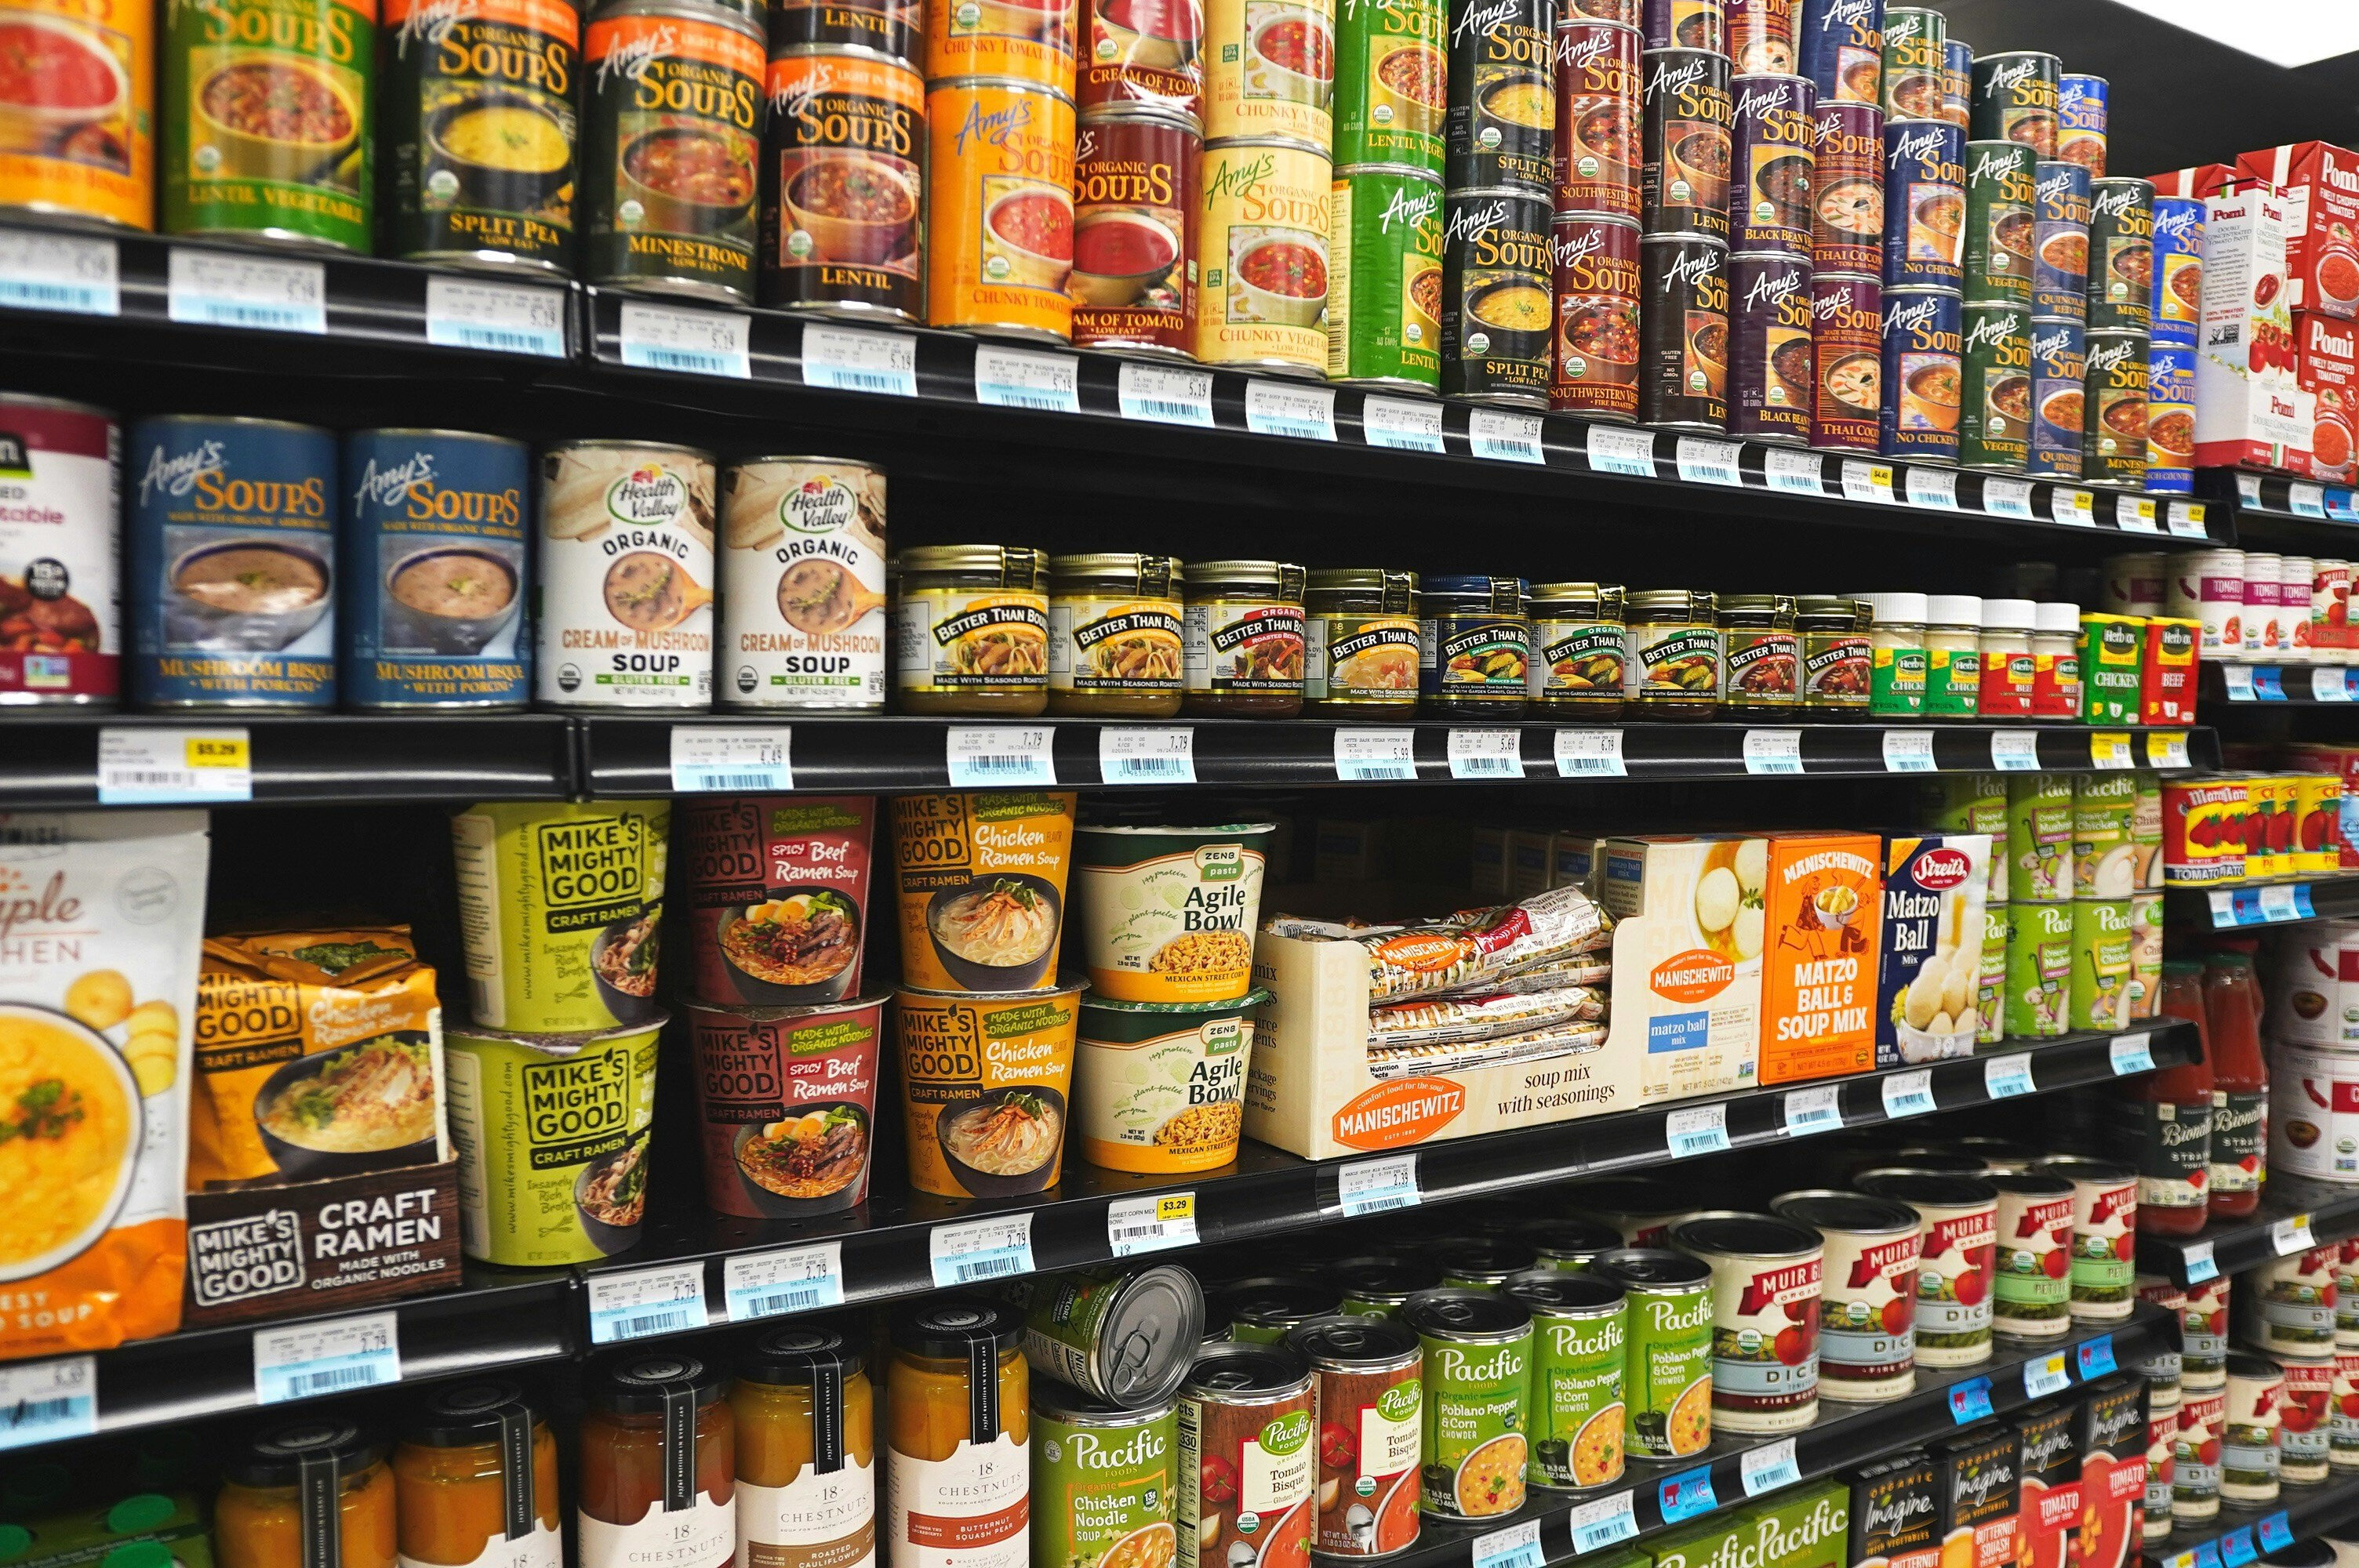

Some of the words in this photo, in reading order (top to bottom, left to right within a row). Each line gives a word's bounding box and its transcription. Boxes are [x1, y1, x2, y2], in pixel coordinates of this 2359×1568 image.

[825, 10, 895, 36] LENTIL
[1646, 58, 1707, 105] Amy's
[1985, 59, 2037, 98] Amy's
[634, 62, 758, 130] SOUPS
[825, 100, 889, 119] ORGANIC
[1236, 103, 1298, 118] CHUNKY
[1732, 84, 1790, 129] Amy's
[1368, 133, 1415, 151] LENTIL
[1499, 155, 1532, 172] SPLIT
[450, 212, 518, 240] SPLIT
[523, 219, 560, 247] PEA
[628, 234, 748, 272] MINESTRONE
[1815, 250, 1848, 261] THAI
[973, 289, 1022, 308] CHUNKY
[1189, 382, 1207, 397] 5.19
[1308, 408, 1325, 424] 5.19
[1425, 424, 1440, 437] 5.19
[1523, 423, 1538, 437] 5.19
[195, 470, 326, 517] SOUPS
[619, 481, 675, 501] Health
[791, 491, 844, 510] Health
[406, 481, 521, 525] SOUPS
[631, 499, 678, 519] Valley
[801, 508, 849, 528] Valley
[1261, 608, 1302, 618] ORGANIC
[1078, 619, 1128, 645] BETTER
[1130, 615, 1161, 628] THAN
[1216, 622, 1263, 648] BETTER
[1265, 619, 1292, 631] THAN
[740, 633, 791, 652] CREAM
[794, 638, 805, 648] OF
[807, 633, 881, 654] MUSHROOM
[1445, 633, 1488, 656] BETTER
[1490, 630, 1516, 641] THAN
[612, 654, 680, 672] SOUP
[785, 656, 850, 673] SOUP
[1729, 647, 1768, 667] BETTER
[1772, 644, 1790, 655] THAN
[376, 662, 483, 680] MUSHROOM
[488, 662, 524, 680] BISQUE
[785, 676, 824, 685] GLUTEN
[827, 677, 851, 685] FREE
[2094, 673, 2139, 688] CHICKEN
[2162, 673, 2185, 687] BEEF
[1023, 732, 1043, 746] 7.79
[1170, 735, 1187, 750] 7.79
[1500, 739, 1515, 750] 5.69
[1601, 739, 1614, 751] 6.79
[1394, 749, 1408, 760] 5.99
[974, 825, 1044, 847] Chicken
[811, 841, 849, 861] Beef
[900, 836, 963, 862] GOOD
[980, 847, 1034, 867] Ramen
[1038, 851, 1060, 869] Soup
[776, 862, 831, 880] Ramen
[834, 864, 858, 881] Soup
[1209, 866, 1237, 877] pasta
[1783, 852, 1873, 884] MANISCHEWITZ
[1915, 849, 1969, 878] Streit's
[1183, 886, 1245, 908] Agile
[1888, 891, 1940, 919] Matzo
[1183, 908, 1244, 931] Bowl
[1894, 921, 1928, 951] Ball
[1902, 956, 1918, 965] Mix
[1655, 965, 1733, 988] MANISCHEWITZ
[1794, 959, 1857, 986] MATZO
[1652, 1022, 1685, 1036] matzo
[1688, 1019, 1706, 1032] ball
[1777, 1014, 1830, 1040] SOUP
[1833, 1007, 1867, 1031] MIX
[987, 1039, 1053, 1061] Chicken
[1213, 1040, 1237, 1050] pasta
[1671, 1035, 1686, 1046] mix
[791, 1063, 820, 1076] SPICY
[827, 1058, 861, 1077] Beef
[990, 1061, 1043, 1080] Ramen
[1045, 1064, 1066, 1077] Soup
[1189, 1059, 1242, 1083] Agile
[1370, 1065, 1399, 1074] Nutrition
[1525, 1071, 1561, 1089] soup
[1564, 1065, 1590, 1082] mix
[534, 1080, 623, 1112] MIGHTY
[1188, 1081, 1241, 1105] Bowl
[1357, 1091, 1386, 1110] comfort
[1387, 1083, 1404, 1095] food
[1405, 1082, 1417, 1091] for
[1498, 1096, 1533, 1115] with
[1536, 1086, 1616, 1110] seasonings
[1339, 1090, 1462, 1138] MANISCHEWITZ
[1169, 1147, 1203, 1156] MEXICAN
[1205, 1144, 1228, 1153] STREET
[1394, 1174, 1408, 1186] 2.39
[318, 1190, 437, 1230] CRAFT
[1163, 1201, 1186, 1211] $3.29
[315, 1217, 442, 1258] RAMEN
[1007, 1232, 1026, 1248] 2.79
[1943, 1220, 1983, 1241] MUIR
[200, 1239, 293, 1273] MIGHTY
[1870, 1247, 1910, 1269] MUIR
[203, 1261, 296, 1298] GOOD
[806, 1264, 827, 1279] 2.79
[1763, 1269, 1808, 1294] MUIR
[1547, 1322, 1624, 1357] Pacific
[1435, 1344, 1523, 1381] Pacific
[1662, 1363, 1685, 1374] Corn
[1654, 1376, 1685, 1385] CHOWDER
[1441, 1392, 1478, 1402] Organic
[1564, 1391, 1588, 1403] Corn
[1441, 1404, 1485, 1416] Poblano
[1487, 1399, 1518, 1414] Pepper
[1555, 1403, 1590, 1412] CHOWDER
[1441, 1419, 1450, 1428] &
[1452, 1418, 1477, 1429] Corn
[1180, 1433, 1197, 1447] 330
[1441, 1430, 1478, 1440] CHOWDER
[1067, 1428, 1166, 1469] Pacific
[1104, 1466, 1138, 1477] FOODS
[1270, 1462, 1307, 1480] Tomato
[2110, 1465, 2144, 1487] TOMATO
[1074, 1481, 1117, 1490] Organic
[1272, 1475, 1305, 1494] Bisque
[781, 1496, 866, 1523] CHESTNUTS
[1074, 1494, 1136, 1512] Chicken
[2041, 1493, 2080, 1516] TOMATO
[960, 1515, 1010, 1532] BUTTERNUT
[1075, 1512, 1128, 1526] Noodle
[955, 1531, 991, 1542] SQUASH
[994, 1523, 1013, 1534] PEAR
[1077, 1530, 1100, 1541] SOUP
[1757, 1501, 1848, 1557] Pacific
[798, 1548, 860, 1568] CAULIFLOWER
[811, 1544, 851, 1559] ROASTED
